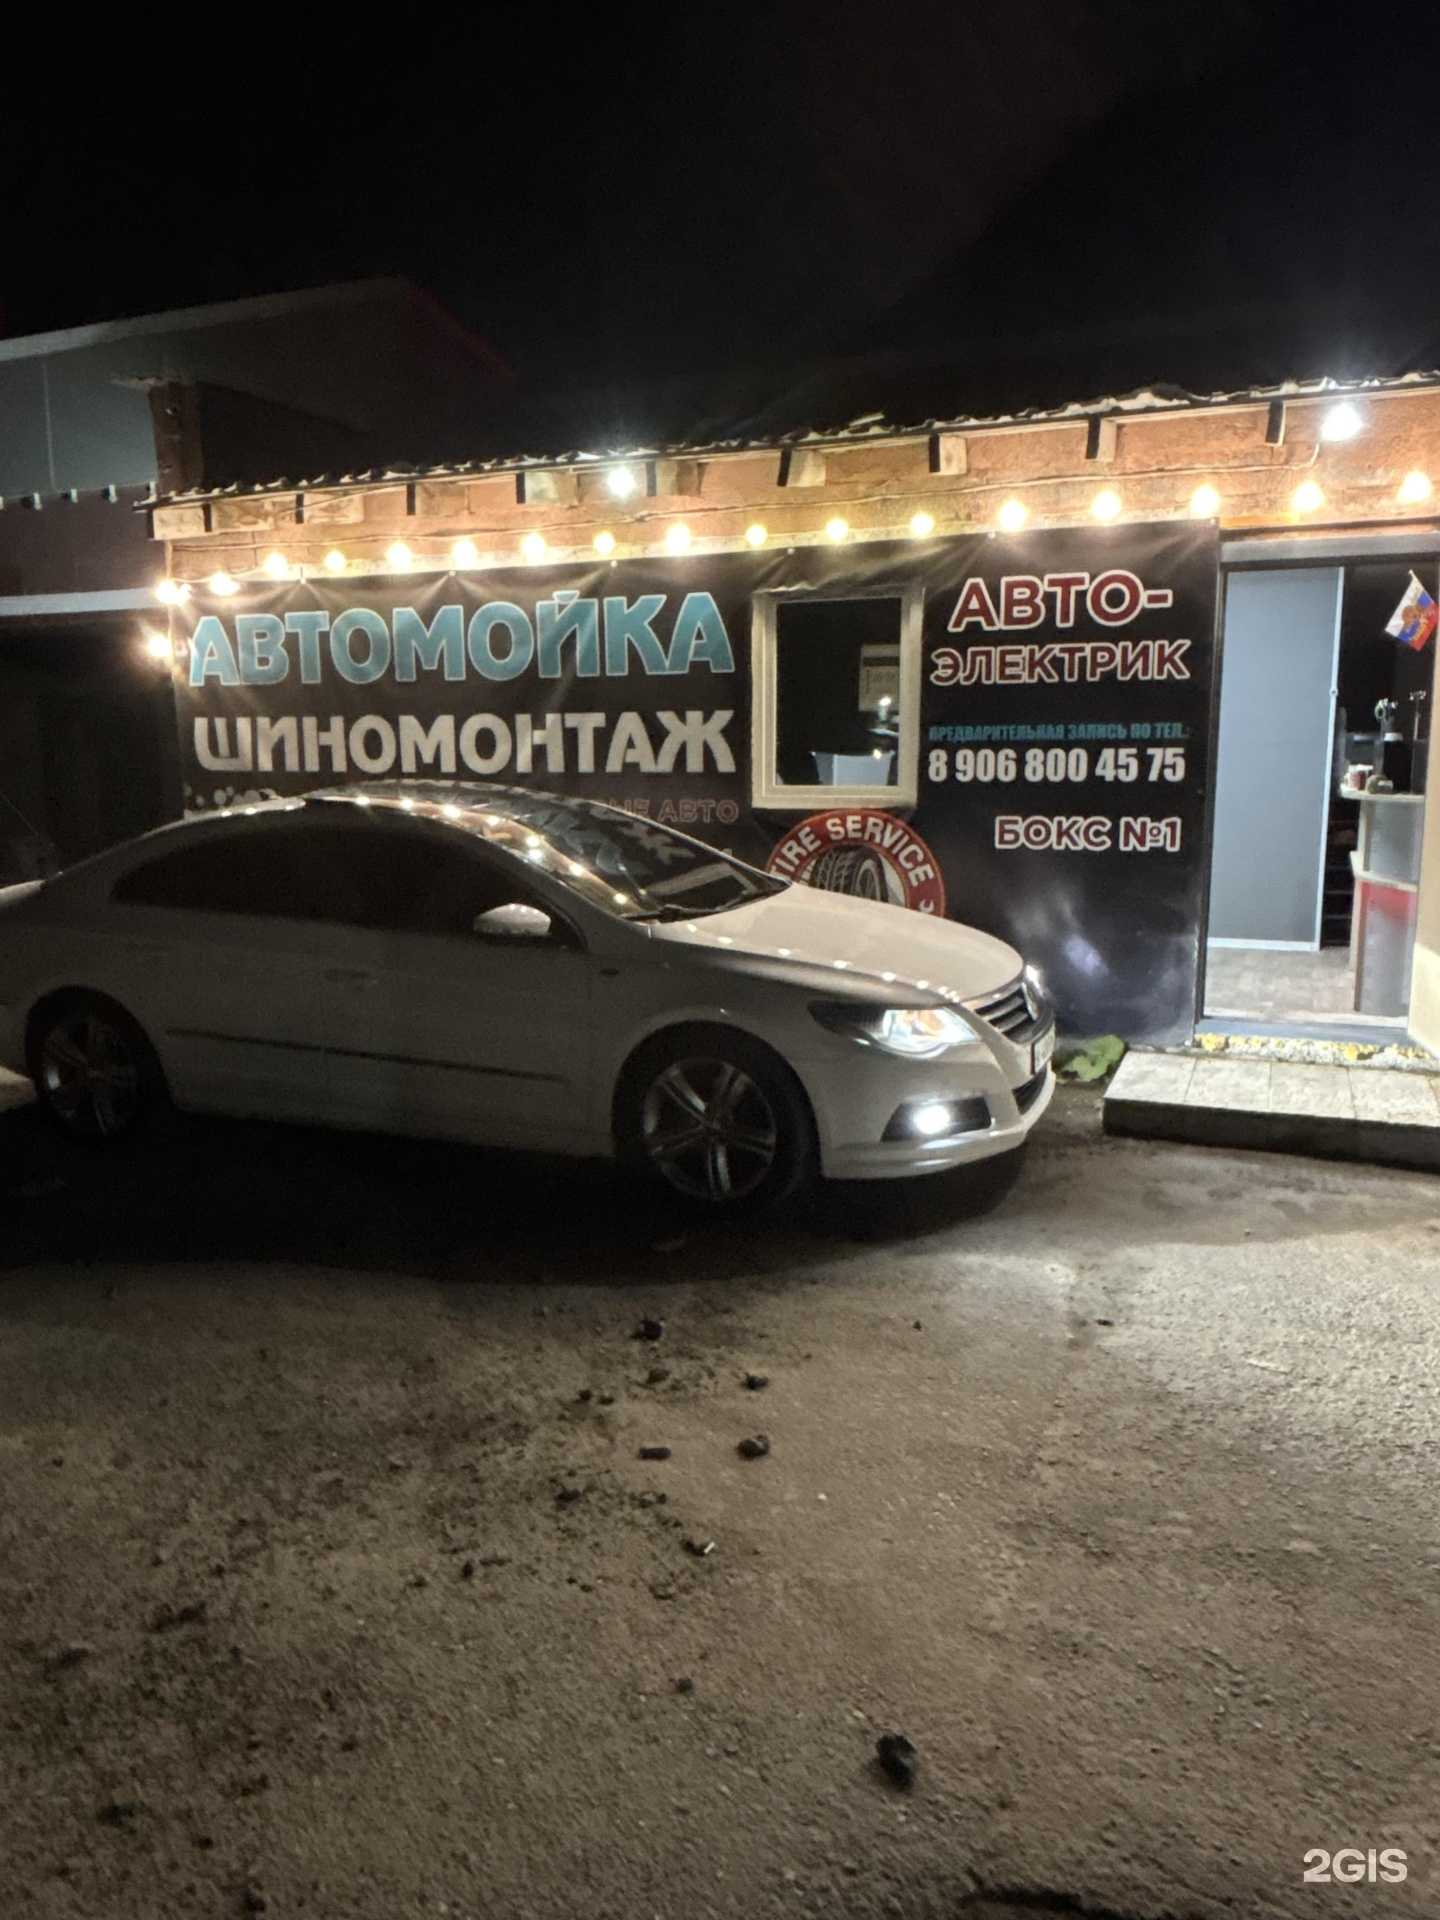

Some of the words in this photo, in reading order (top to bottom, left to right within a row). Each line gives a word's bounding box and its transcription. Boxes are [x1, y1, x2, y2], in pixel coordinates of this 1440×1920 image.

[947, 569, 1174, 632] АВТО-
[189, 590, 735, 687] АВТОМОЙКА
[929, 639, 1191, 686] ЭЛЕКТРИК
[193, 710, 737, 774] ШИНОМОНТАЖ
[928, 724, 1064, 742] ПРЕДВАРИТЕЛЬНАЯ
[1067, 722, 1127, 740] ЗАПИСЬ
[1130, 723, 1151, 739] ПО
[928, 748, 948, 782] 8
[955, 748, 1017, 782] 906
[1024, 748, 1088, 782] 800
[1095, 748, 1138, 782] 45
[1147, 748, 1186, 782] 75
[658, 799, 740, 824] АВТО
[994, 815, 1112, 850] БОКС
[1119, 816, 1182, 852] №1
[825, 815, 935, 887] SERVICE
